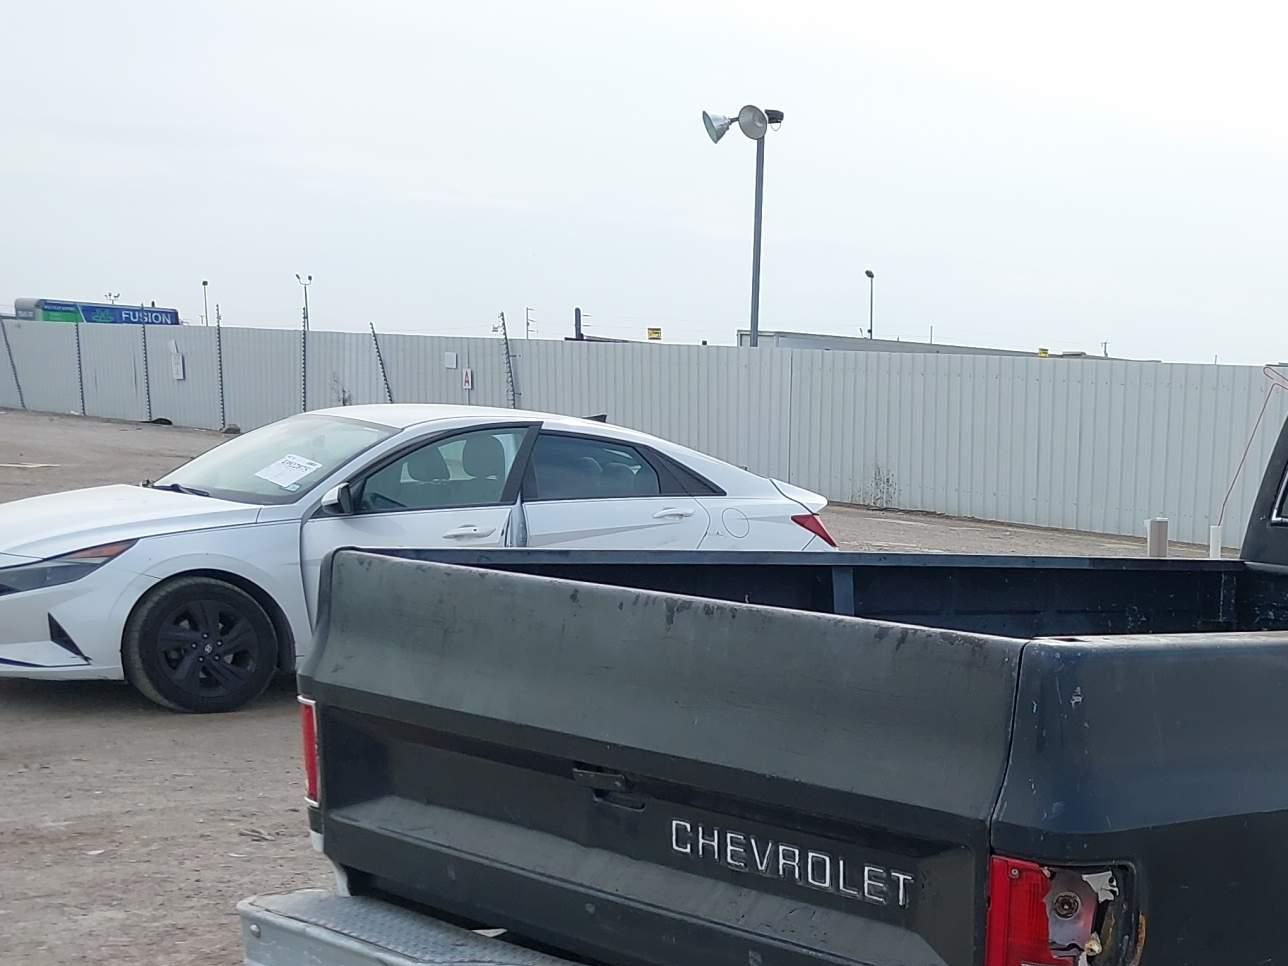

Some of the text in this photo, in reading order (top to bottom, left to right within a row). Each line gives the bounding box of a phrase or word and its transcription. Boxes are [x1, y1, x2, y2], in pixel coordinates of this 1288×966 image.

[121, 310, 172, 324] FUSION
[463, 369, 470, 387] A
[671, 819, 914, 907] CHEVROLET
